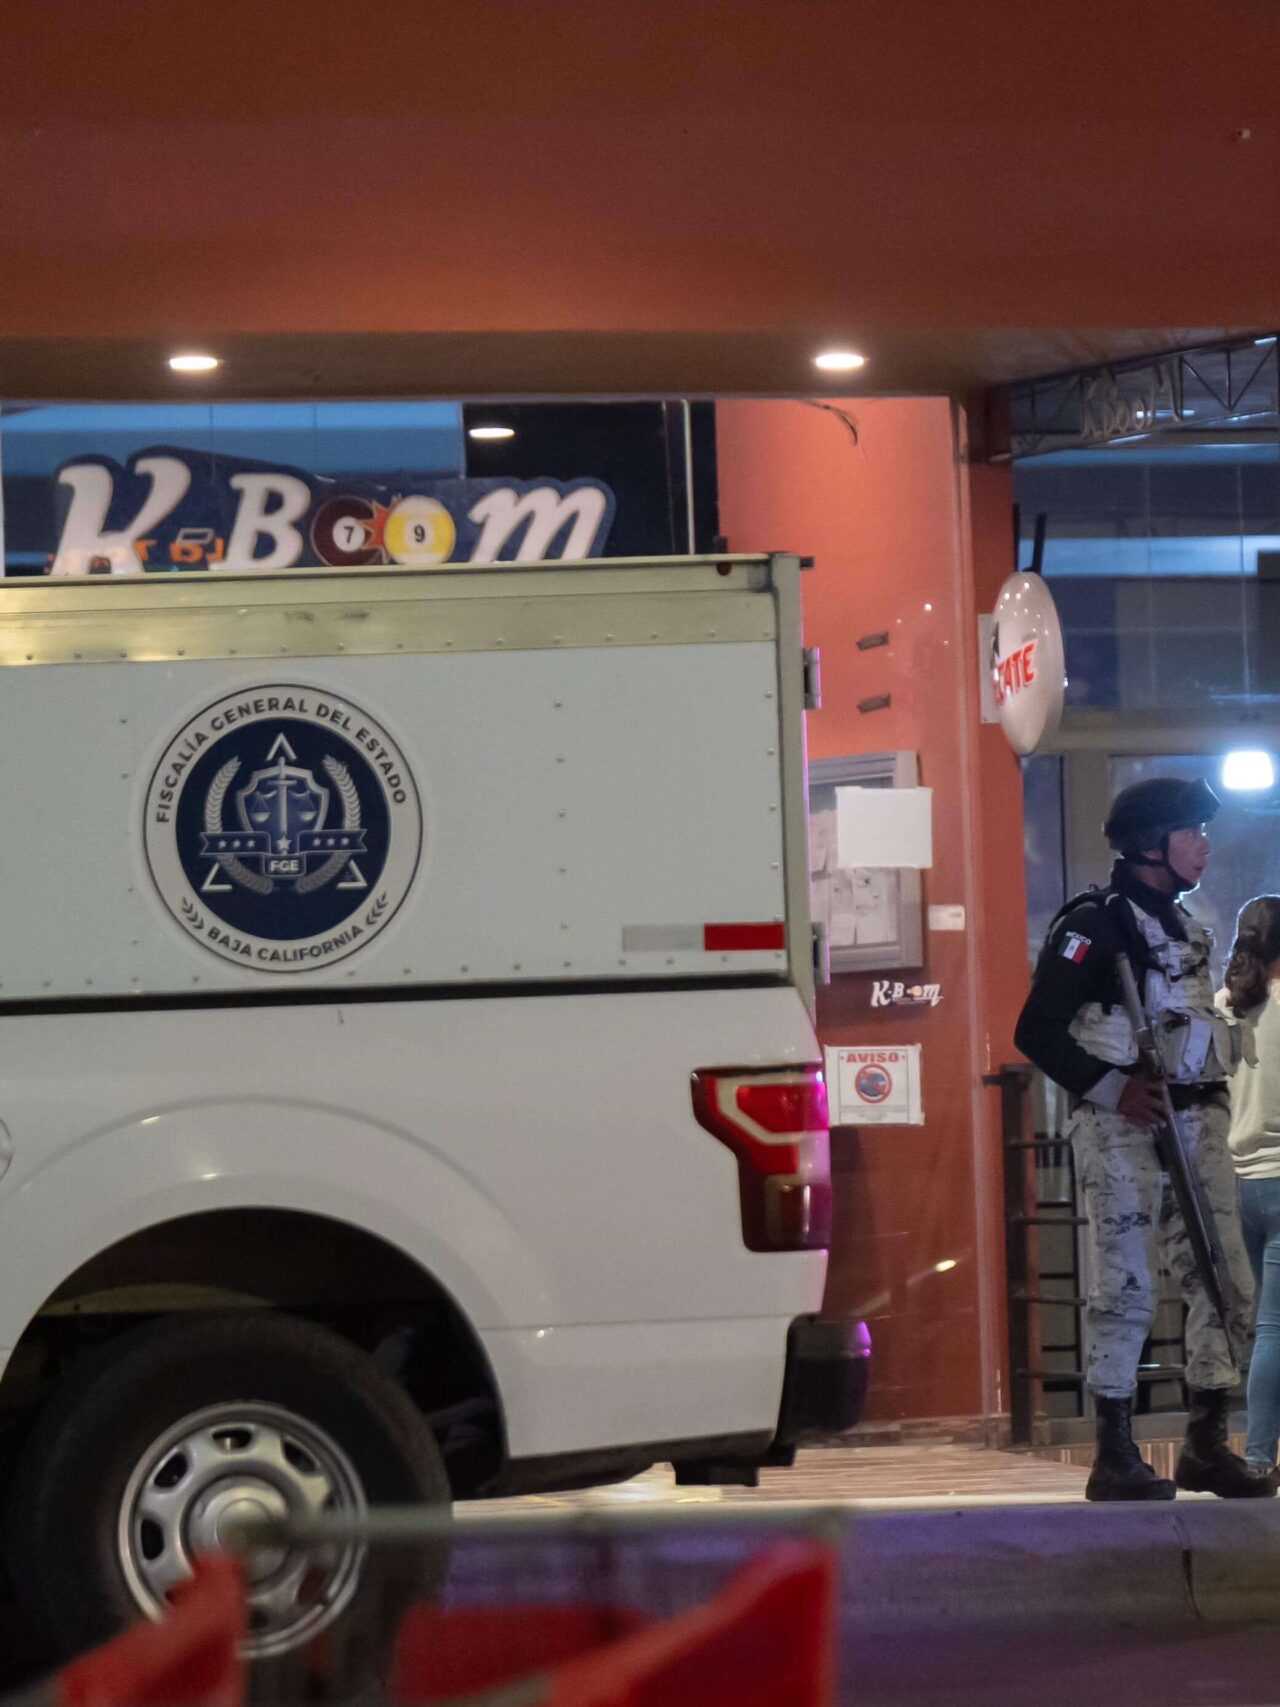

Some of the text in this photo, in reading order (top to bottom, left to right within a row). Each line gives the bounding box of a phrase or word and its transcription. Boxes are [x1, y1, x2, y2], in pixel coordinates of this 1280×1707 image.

[157, 697, 407, 823] FISCALÍA GENERAL DEL ESTADO
[207, 924, 363, 962] BAJA CALIFORNIA
[846, 1052, 899, 1064] AVISO
